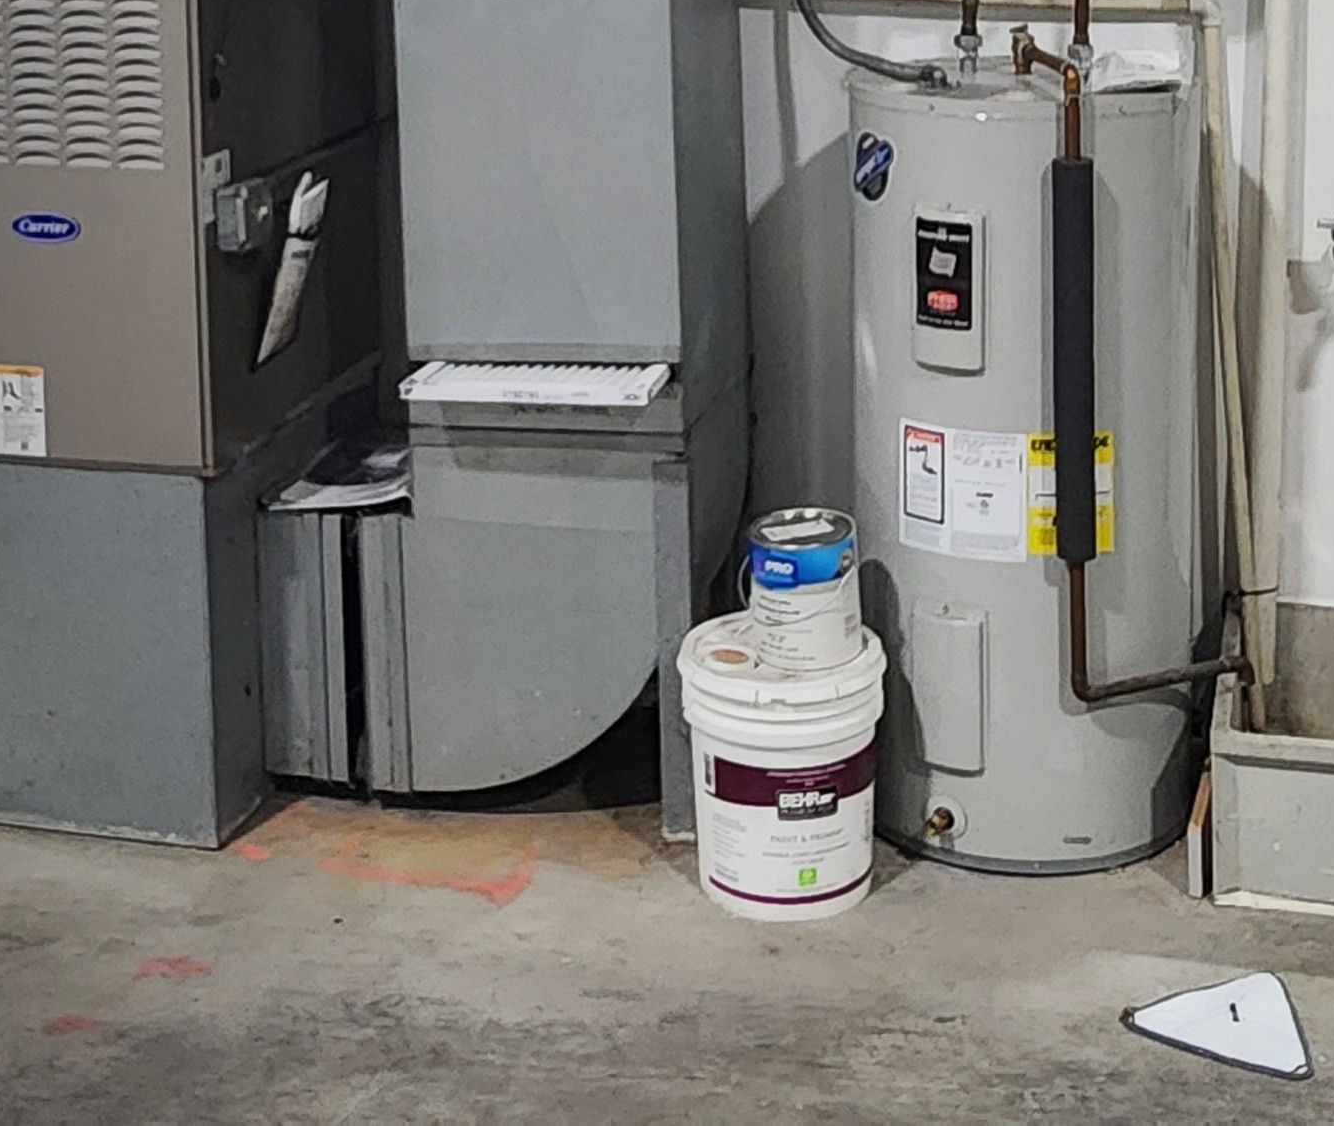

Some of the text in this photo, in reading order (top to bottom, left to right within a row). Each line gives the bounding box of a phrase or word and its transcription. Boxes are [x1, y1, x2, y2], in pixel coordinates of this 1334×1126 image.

[18, 218, 70, 234] Carrier
[764, 560, 794, 575] PRO
[779, 791, 820, 809] BEHR
